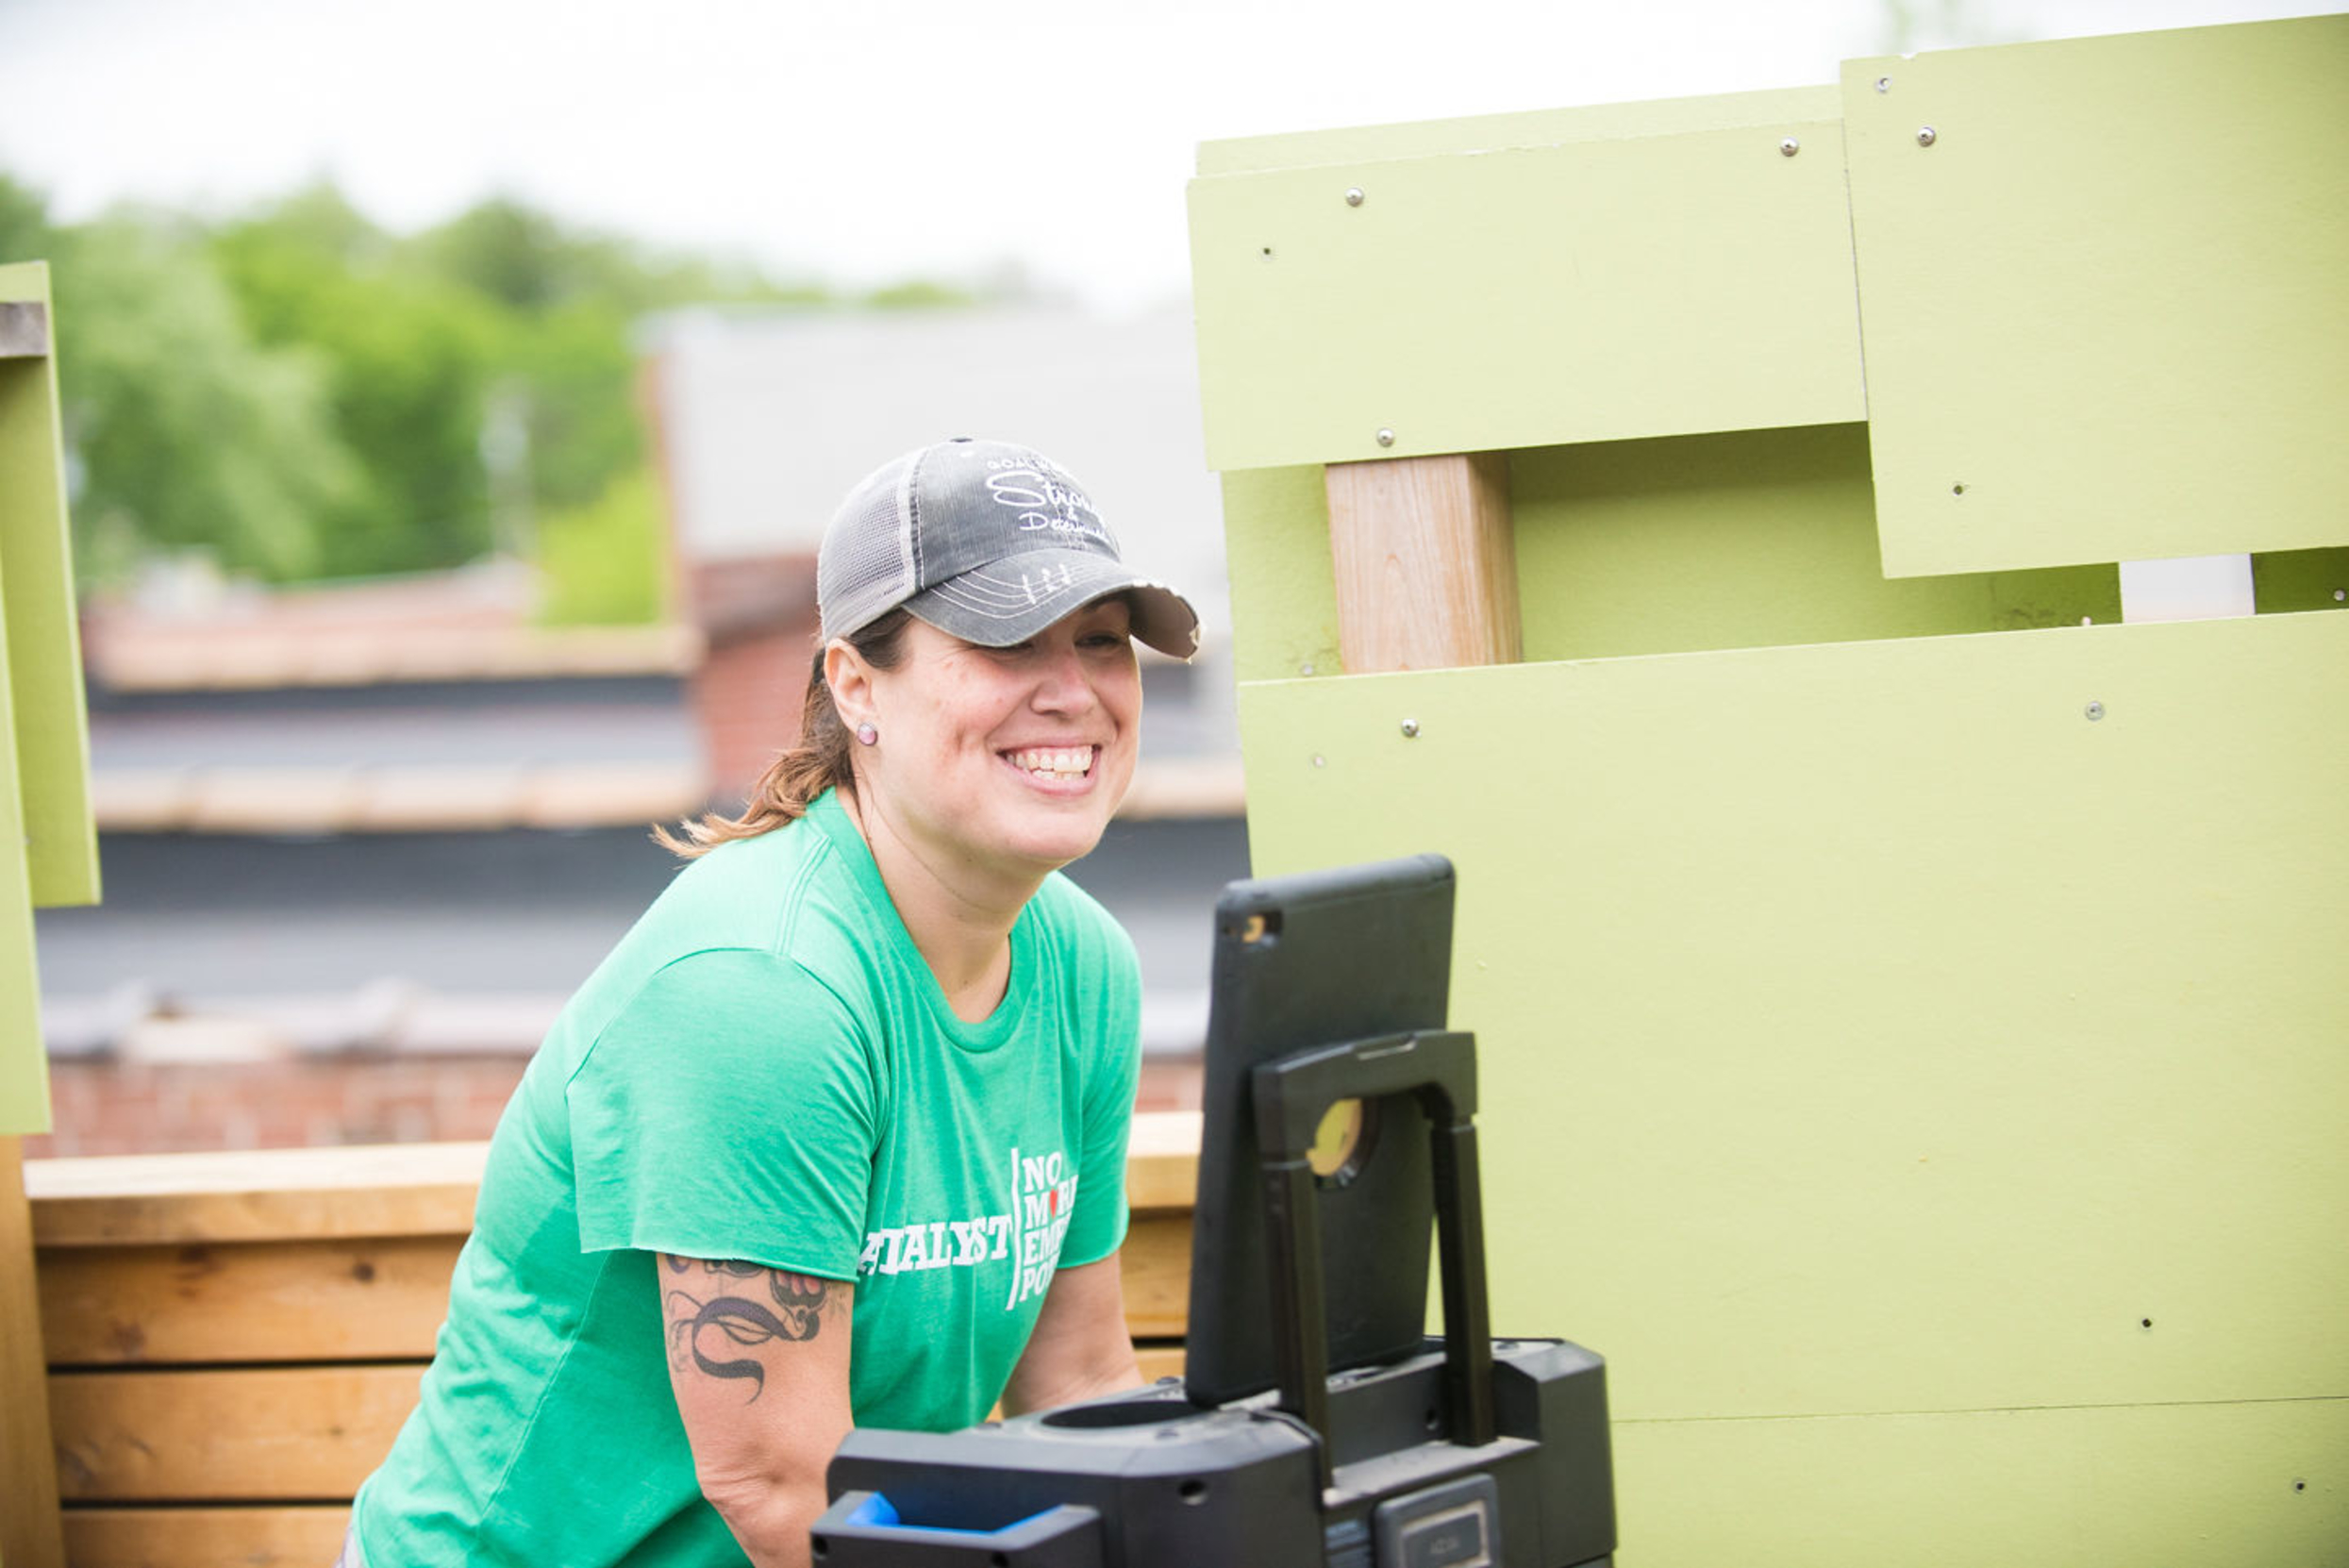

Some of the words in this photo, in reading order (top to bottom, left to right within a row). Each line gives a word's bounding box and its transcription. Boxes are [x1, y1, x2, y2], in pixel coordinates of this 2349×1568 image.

[986, 471, 1094, 511] Stro
[1022, 1151, 1062, 1193] NO
[858, 1213, 1013, 1276] ATALYST
[1024, 1211, 1072, 1266] EMP
[1019, 1252, 1059, 1302] PO
